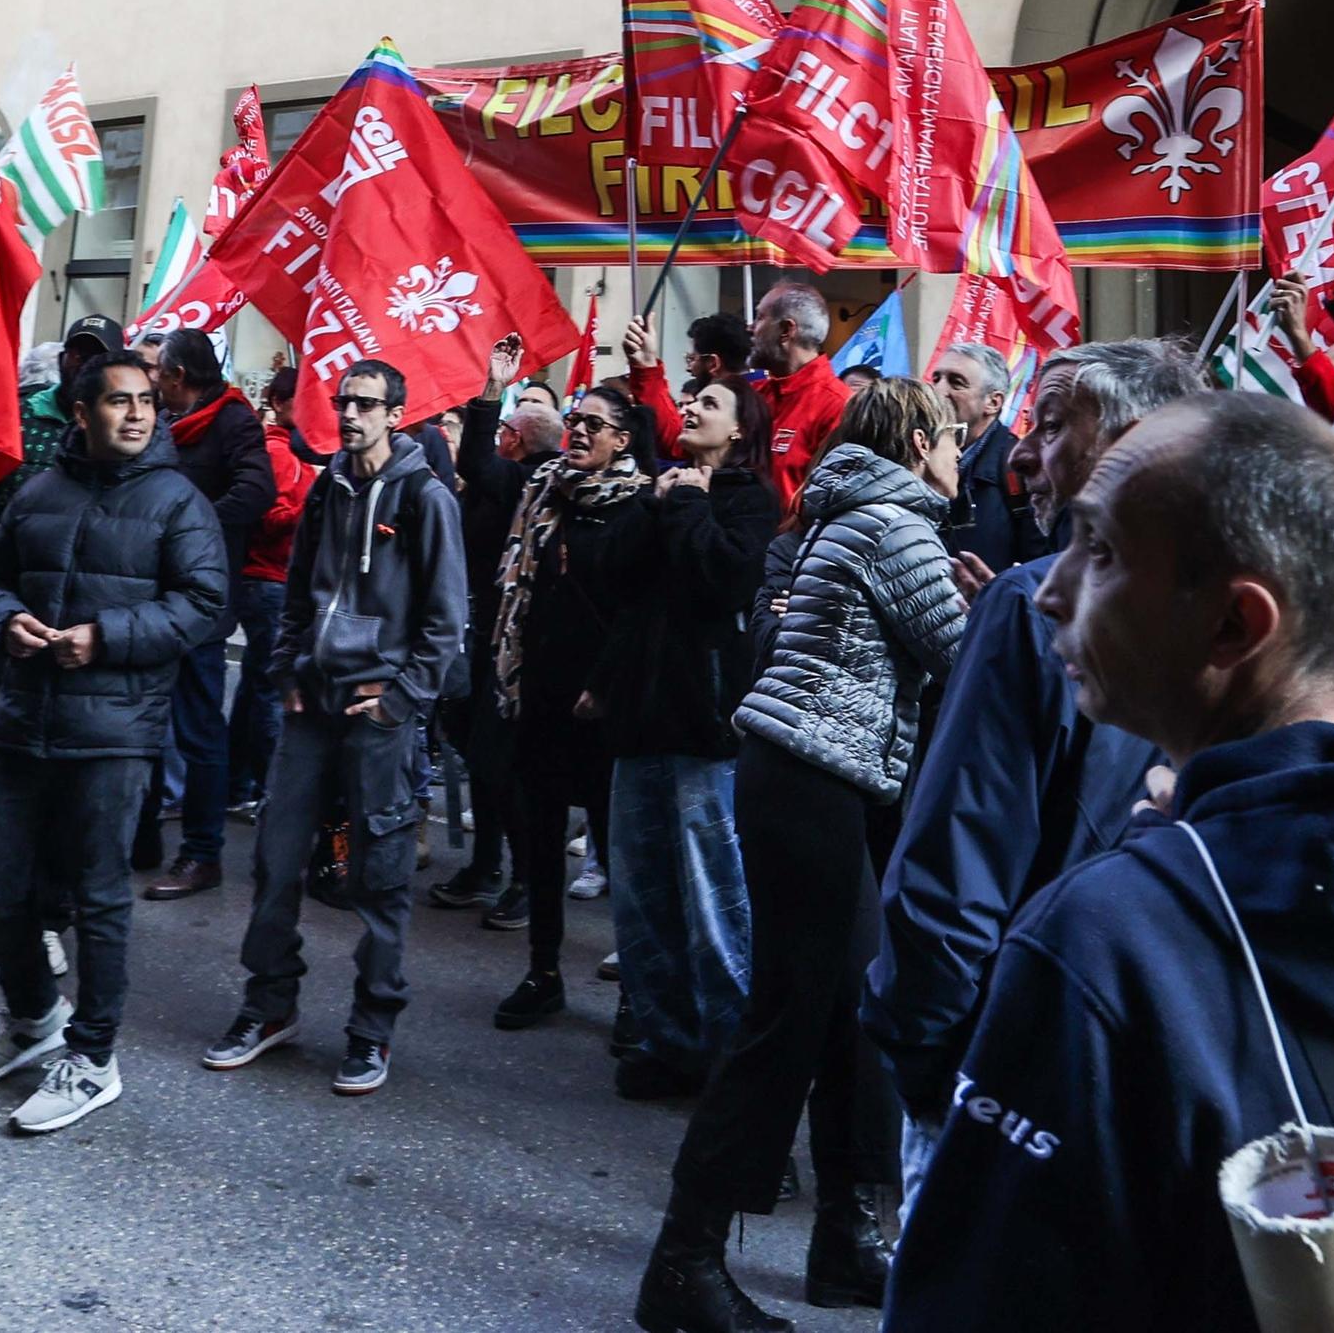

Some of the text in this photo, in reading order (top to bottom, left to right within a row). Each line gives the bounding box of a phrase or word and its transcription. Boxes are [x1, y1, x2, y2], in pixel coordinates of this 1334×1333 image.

[482, 63, 1091, 140] FILC IL
[641, 95, 722, 149] FIL
[787, 50, 894, 171] FILCT
[355, 106, 408, 172] CGIL
[740, 158, 843, 251] CGIL
[334, 294, 383, 355] ITALIANI
